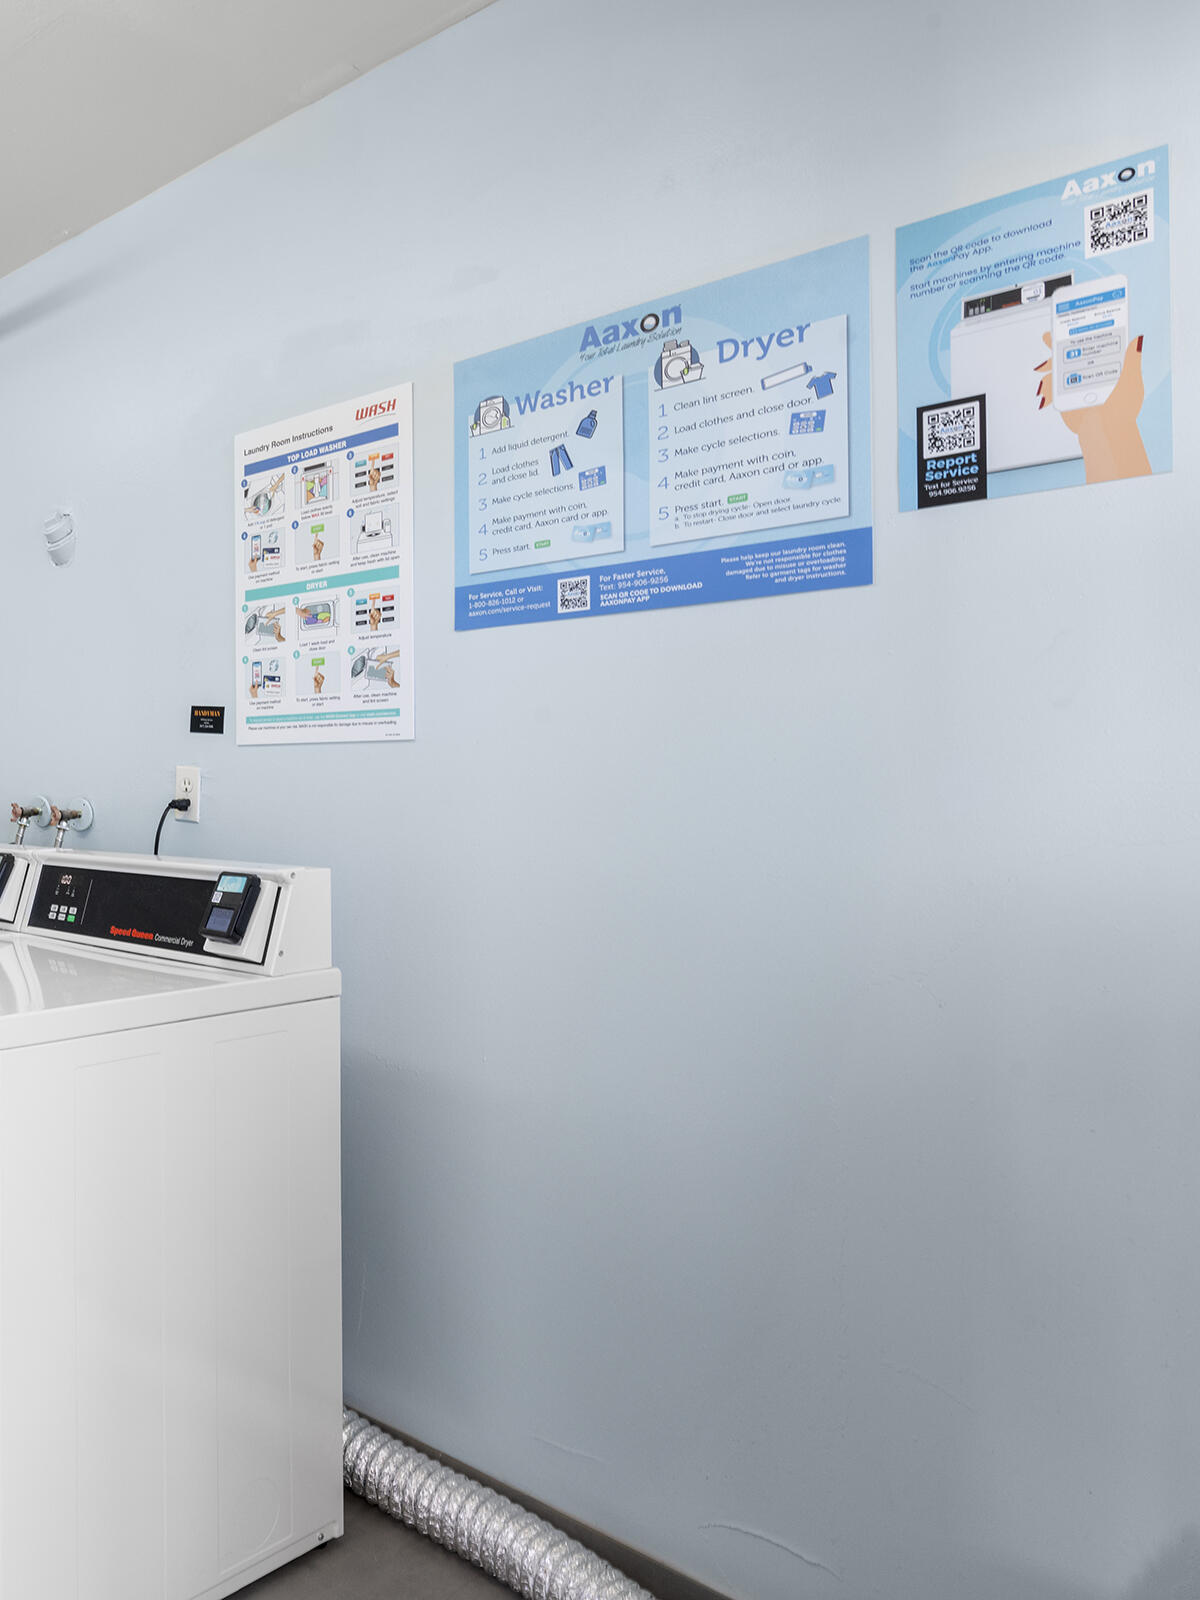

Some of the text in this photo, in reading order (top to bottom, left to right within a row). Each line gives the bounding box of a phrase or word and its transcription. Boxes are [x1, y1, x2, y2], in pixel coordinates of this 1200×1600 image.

[1061, 160, 1155, 200] Aaxon
[910, 219, 1052, 265] Scan the QR code to download
[910, 240, 1081, 291] Start machines by entering machine
[910, 264, 924, 272] the
[910, 260, 1037, 299] number or scanning the QR
[580, 305, 682, 352] Aaxon
[717, 323, 810, 364] Dryer
[579, 352, 595, 362] Your
[515, 376, 614, 415] Washer
[658, 404, 667, 418] 1
[674, 398, 700, 412] Clean
[702, 394, 718, 405] lint
[355, 398, 397, 421] WASH
[657, 426, 669, 440] 2
[674, 422, 697, 435] Load
[699, 414, 734, 429] clothes
[736, 409, 755, 420] and
[757, 403, 784, 415] close
[243, 425, 334, 456] Laundry Room Instructions
[479, 448, 486, 459] 1
[492, 446, 507, 455] Add
[508, 440, 529, 451] liquid
[657, 448, 669, 462] 3
[674, 445, 699, 456] Make
[701, 436, 726, 451] cycle
[287, 440, 347, 463] TOP LOAD WASHER
[926, 453, 977, 470] Report
[478, 459, 539, 485] 2 Load clothes
[491, 472, 525, 485] and close
[657, 450, 796, 490] 4 Make payment with coin,
[674, 478, 701, 491] credit
[729, 468, 760, 481] Aaxon
[763, 463, 784, 475] card
[788, 460, 799, 470] or
[925, 464, 979, 481] Service
[952, 477, 978, 486] Service
[478, 498, 488, 511] 3
[492, 495, 511, 505] Make
[513, 489, 532, 502] cycle
[692, 501, 773, 519] stop drying Open
[478, 505, 566, 536] 4 Make payment with
[658, 506, 669, 520] 5
[675, 503, 698, 514] Press
[717, 501, 820, 522] Close door and select laundry
[492, 524, 512, 535] credit
[534, 517, 559, 528] Aaxon
[561, 513, 579, 523] card
[581, 511, 589, 519] or
[479, 545, 511, 561] 5 Press
[755, 552, 770, 560] keep
[782, 547, 807, 555] laundry
[775, 553, 811, 563] responsible
[613, 571, 635, 580] Faster
[725, 567, 753, 577] damaged
[770, 569, 796, 578] garment
[797, 567, 811, 575] tags
[788, 575, 805, 583] dryer
[306, 580, 328, 590] DRYER
[505, 588, 518, 596] Call
[600, 592, 618, 600] SCAN
[619, 590, 629, 598] QR
[630, 588, 648, 597] CODE
[660, 581, 703, 593] DOWNLOAD
[600, 597, 636, 607] AAXONPAY
[110, 925, 194, 948] Speed Queen Commercial Dryer
